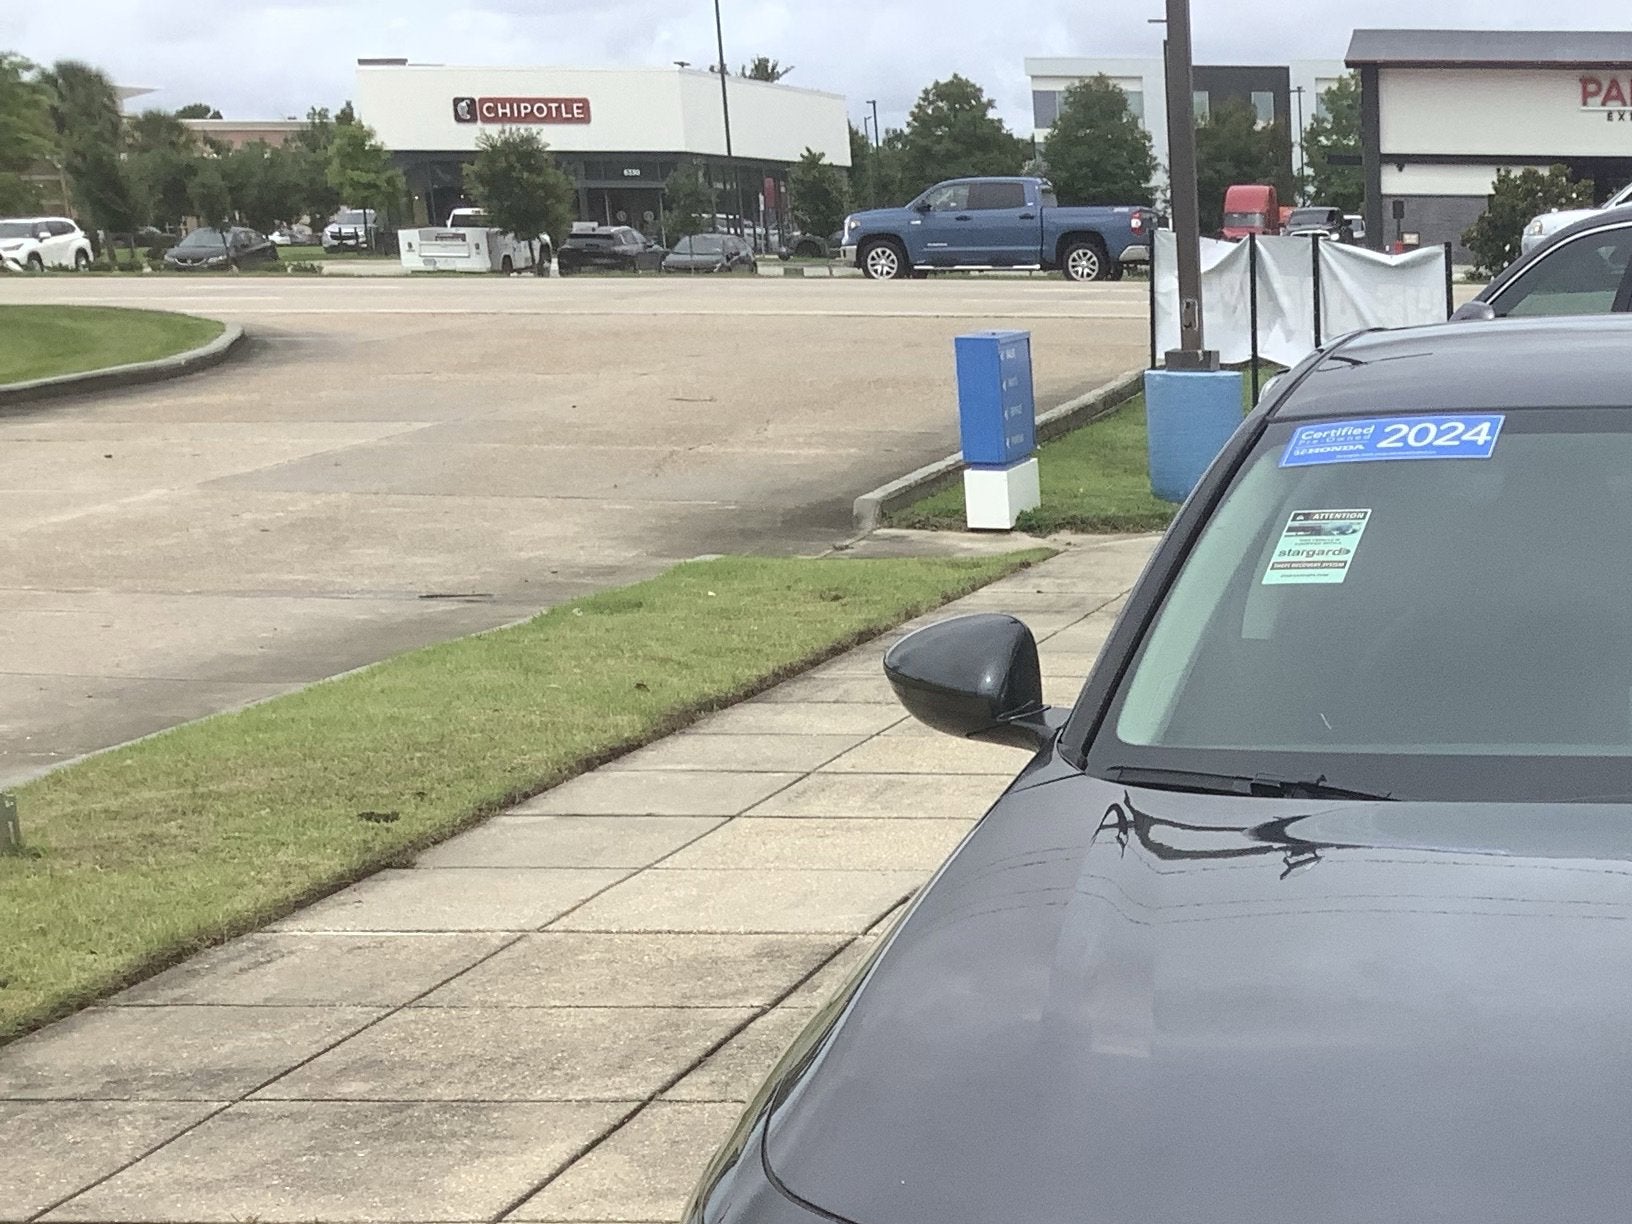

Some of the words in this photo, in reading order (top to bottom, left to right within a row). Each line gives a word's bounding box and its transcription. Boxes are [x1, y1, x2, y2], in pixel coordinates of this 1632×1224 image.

[482, 102, 585, 118] CHIPOTLE
[1297, 434, 1372, 446] Pre-Owned
[1300, 424, 1376, 441] Certified
[1376, 421, 1492, 448] 2024
[1308, 444, 1365, 454] HONDA
[1312, 512, 1365, 520] ATTENTION
